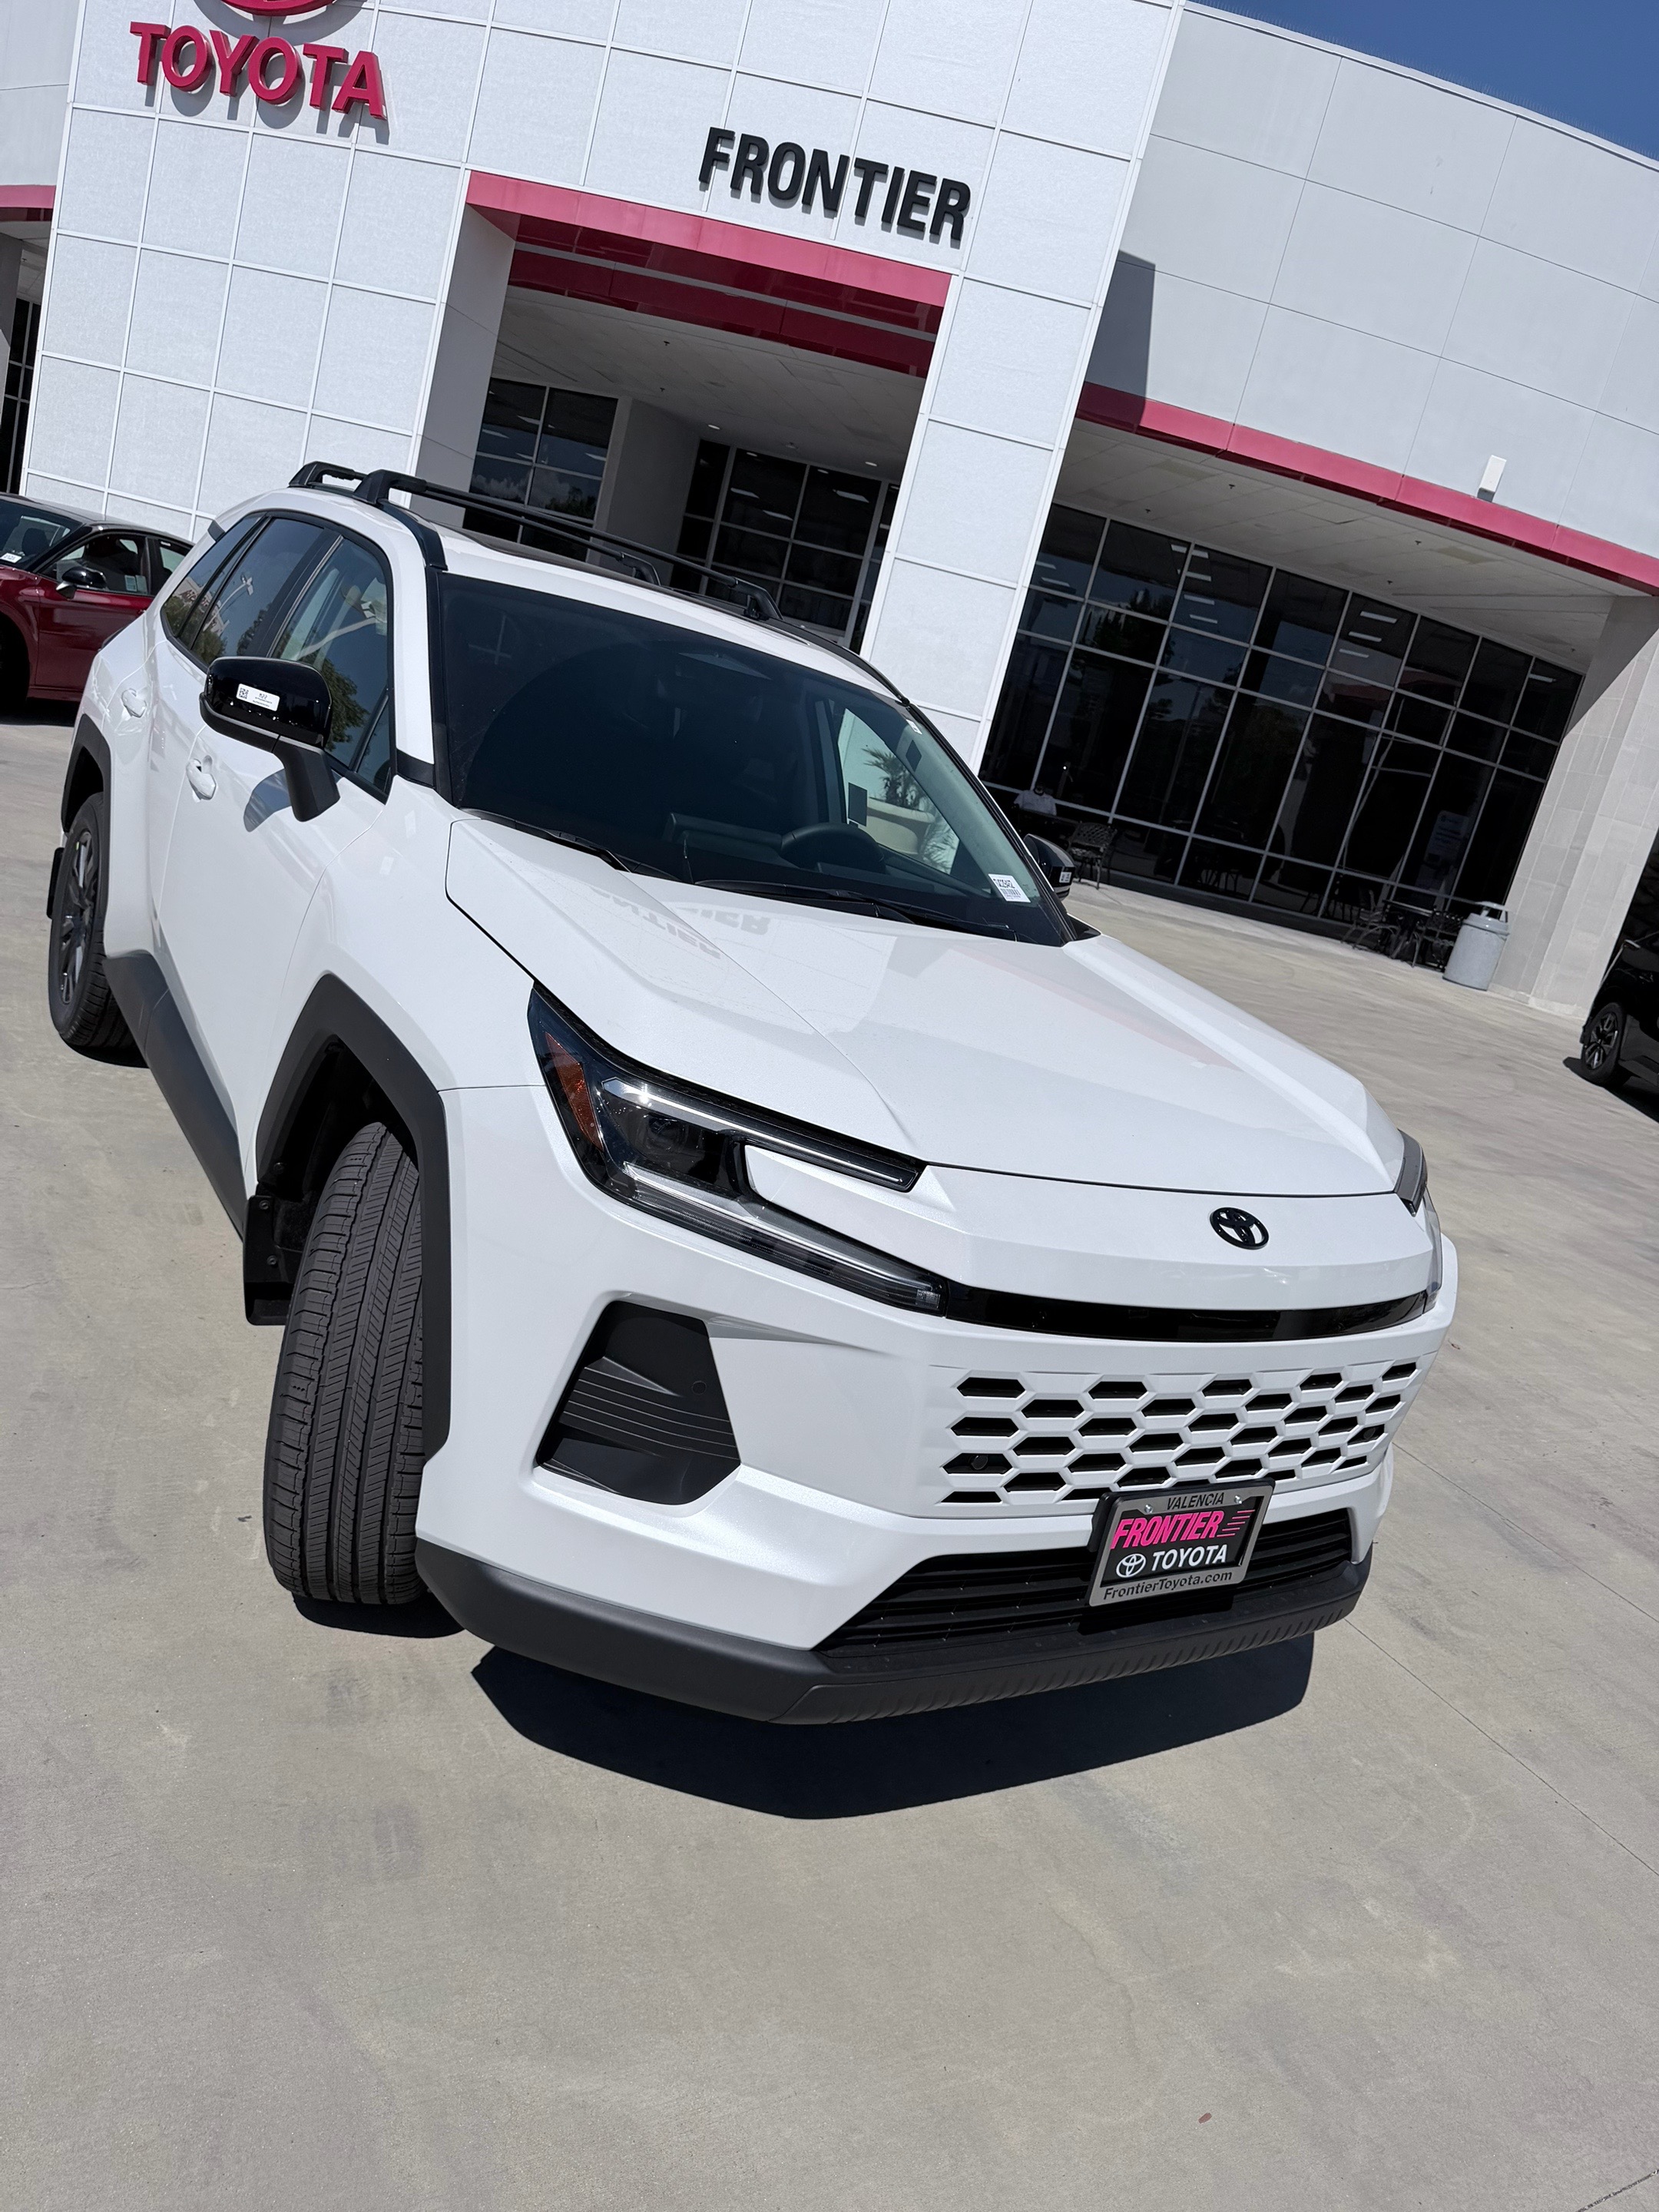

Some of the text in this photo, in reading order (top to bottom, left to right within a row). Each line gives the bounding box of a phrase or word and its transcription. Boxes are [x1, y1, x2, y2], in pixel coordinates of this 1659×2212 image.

[130, 22, 387, 121] TOYOTA
[698, 127, 971, 241] FRONTIER
[1167, 1492, 1224, 1510] VALENCIA
[1111, 1511, 1224, 1548] FRONTIER
[1152, 1545, 1227, 1571] TOYOTA
[1104, 1571, 1232, 1599] FrontierToyota.com
